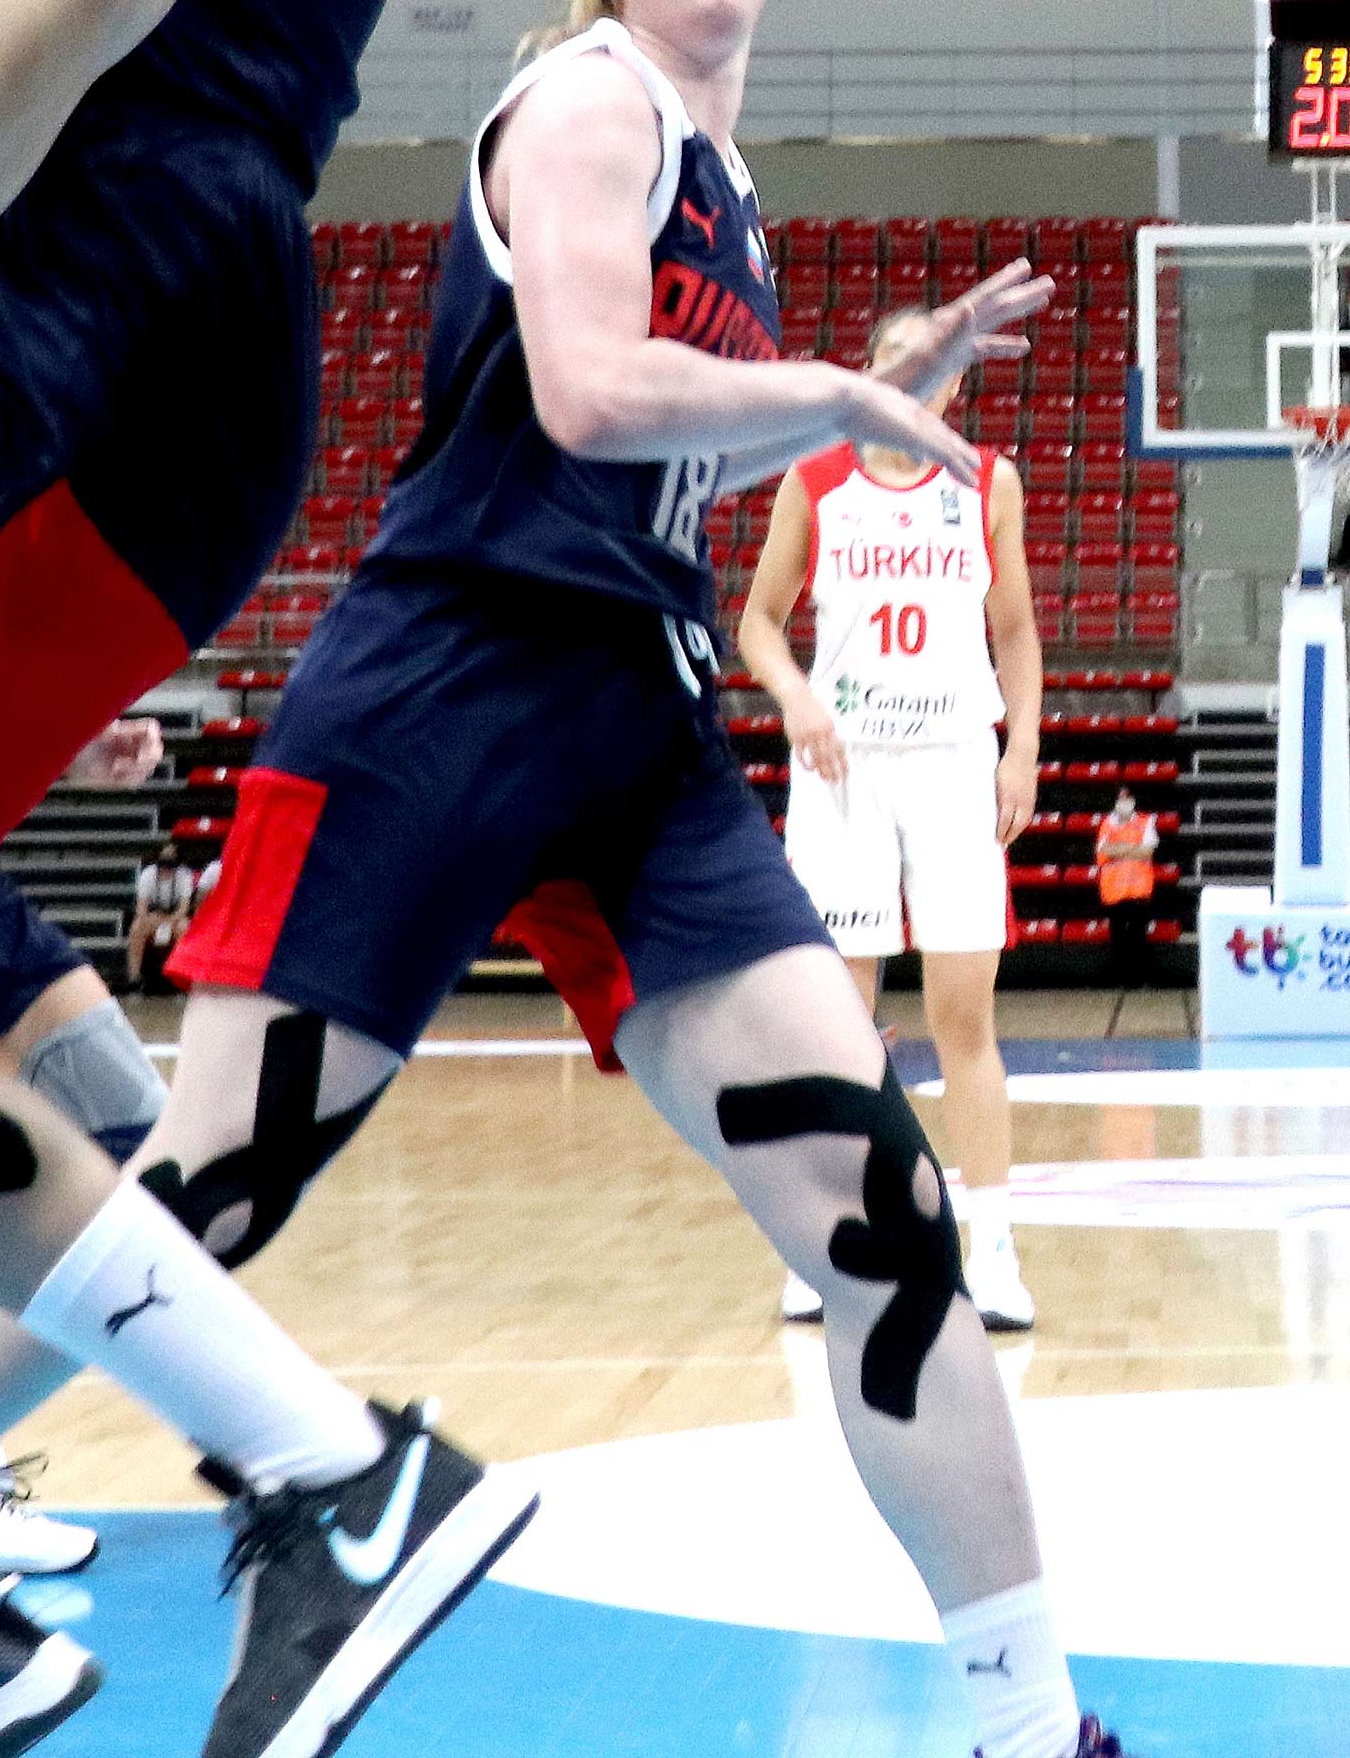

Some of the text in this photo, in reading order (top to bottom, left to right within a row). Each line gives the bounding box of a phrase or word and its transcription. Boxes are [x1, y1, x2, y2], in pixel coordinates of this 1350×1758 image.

[653, 450, 718, 564] 18
[830, 538, 972, 581] TÜRKİYE
[870, 603, 927, 657] 10
